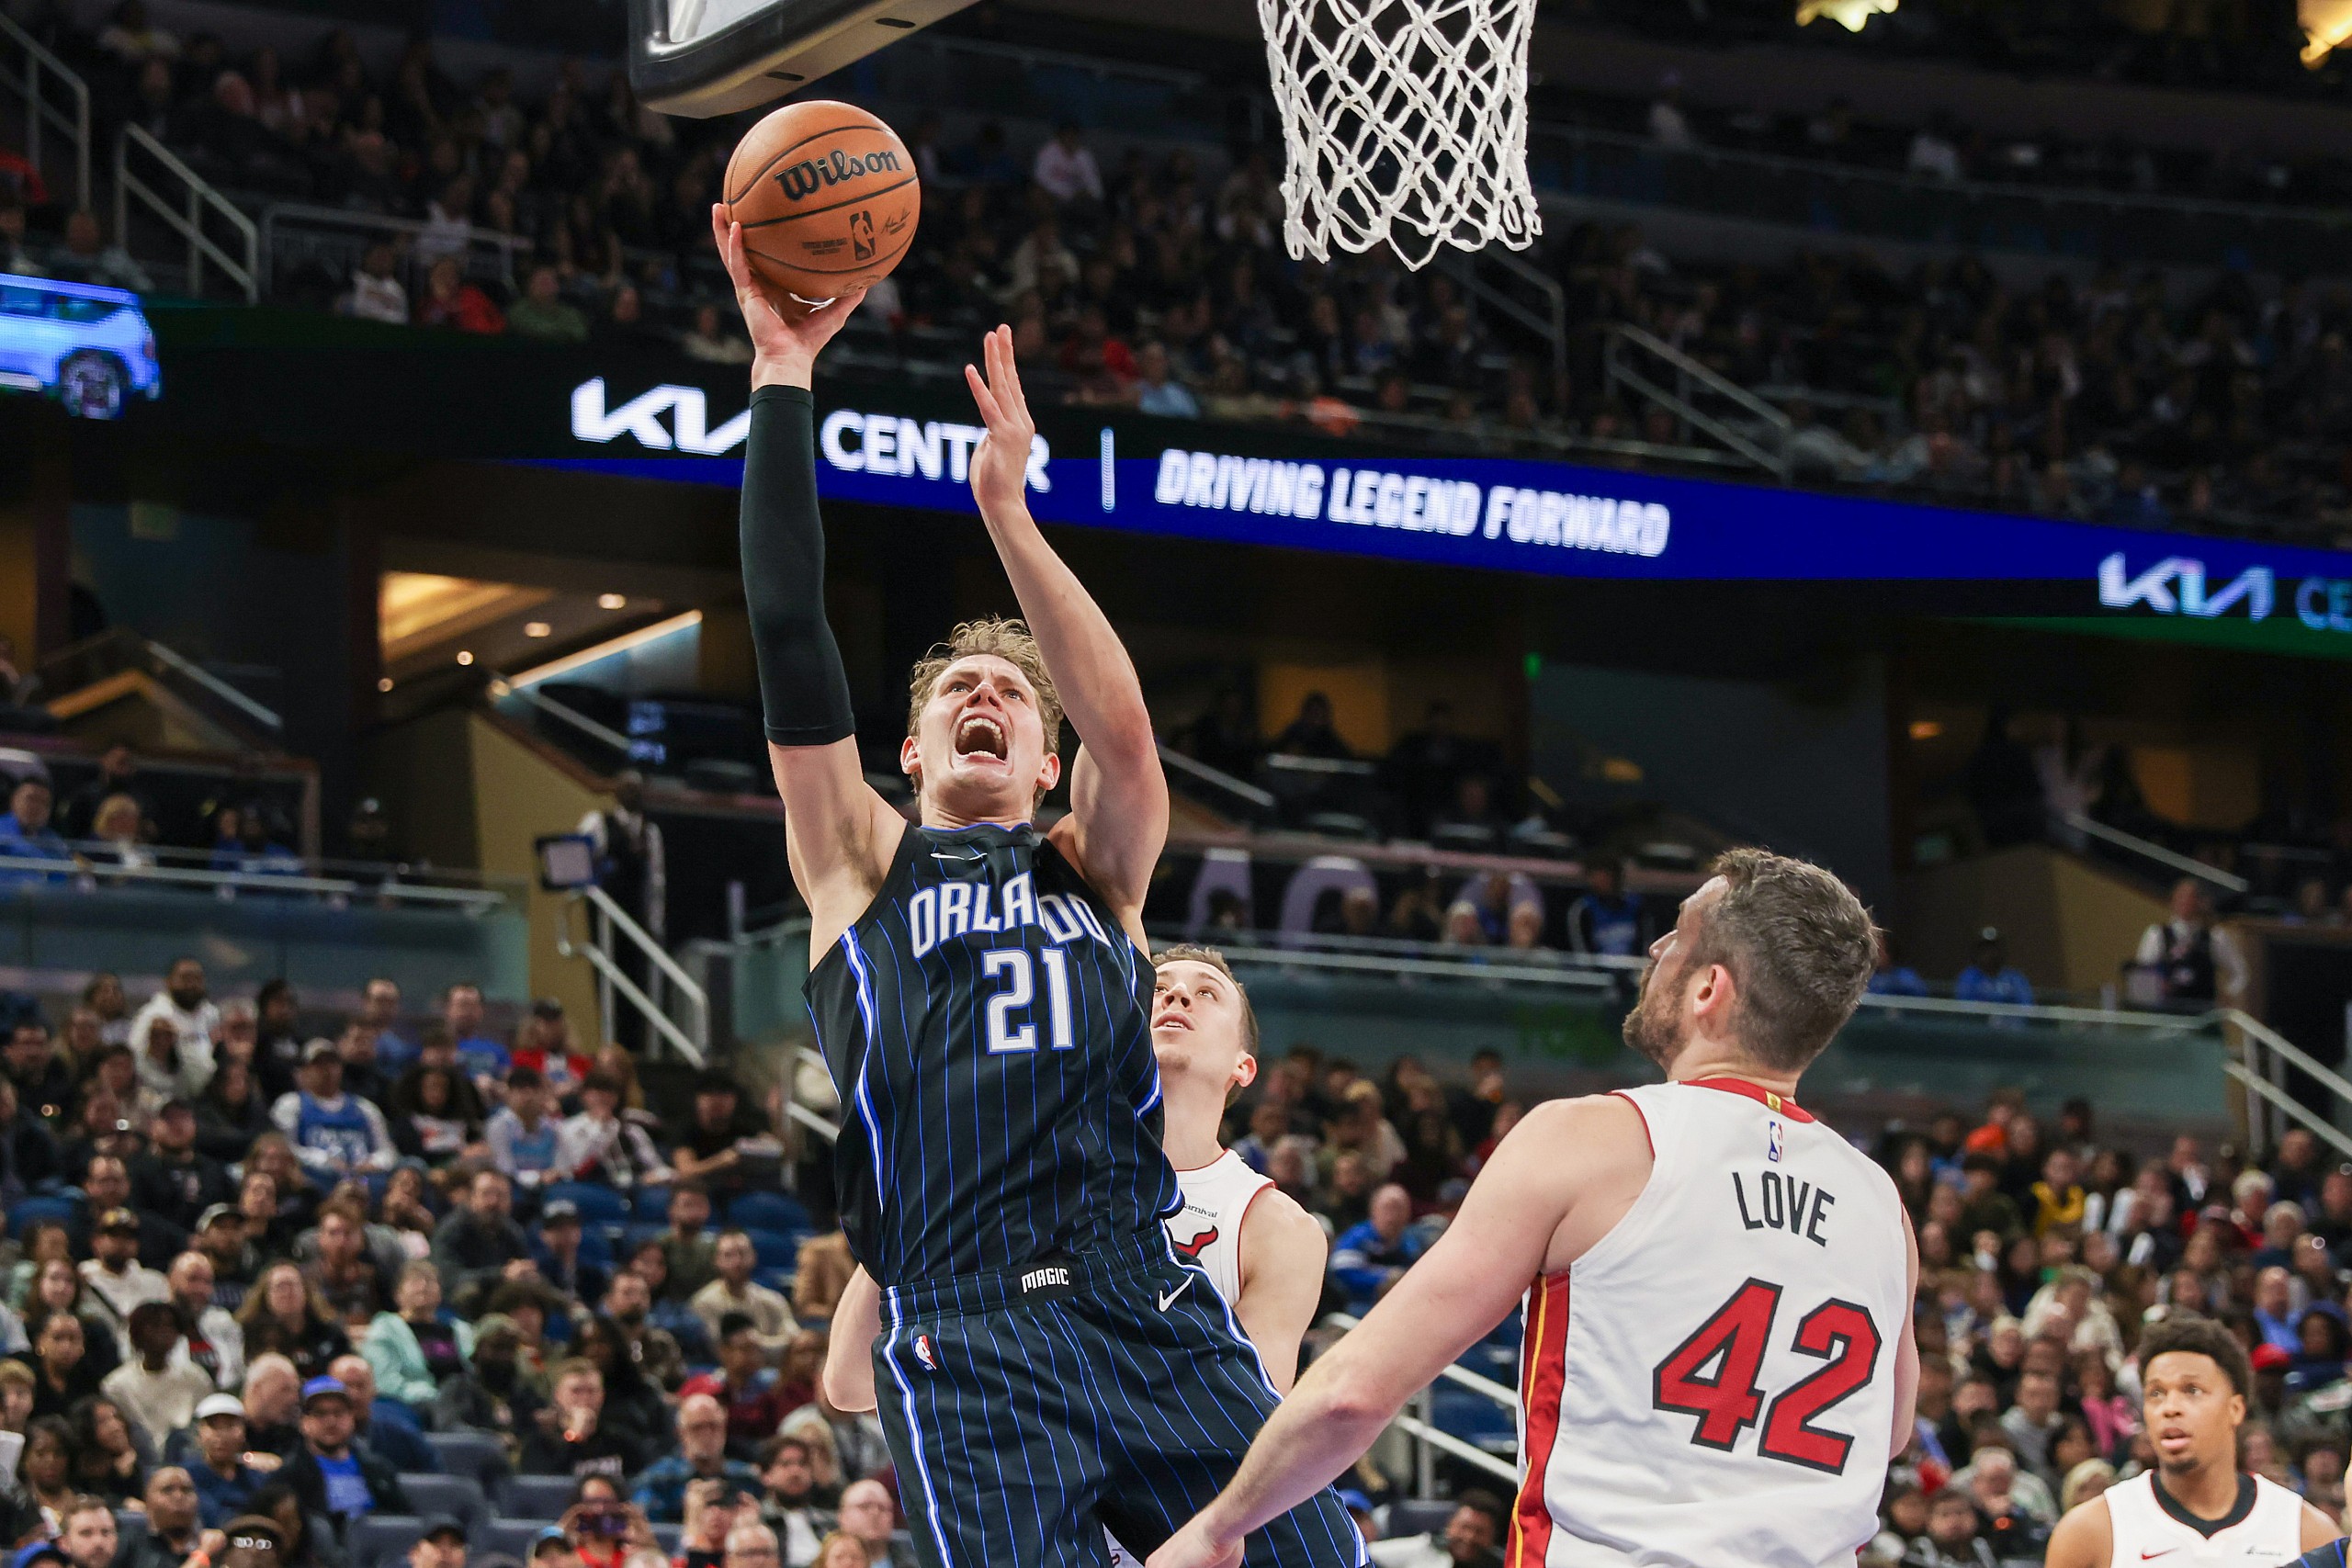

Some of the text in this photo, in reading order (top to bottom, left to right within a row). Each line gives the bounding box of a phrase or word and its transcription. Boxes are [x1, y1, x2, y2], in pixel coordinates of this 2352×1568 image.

[774, 150, 901, 201] Wilson
[820, 410, 1051, 493] CENTR
[1156, 448, 1670, 558] DRIVING LEGEND FORWARD
[910, 871, 1112, 960] ORLADO
[980, 946, 1075, 1055] 21
[1184, 1202, 1218, 1218] arnival
[1732, 1171, 1836, 1247] LOVE
[1021, 1267, 1069, 1293] MAGIC
[1653, 1276, 1883, 1477] 42
